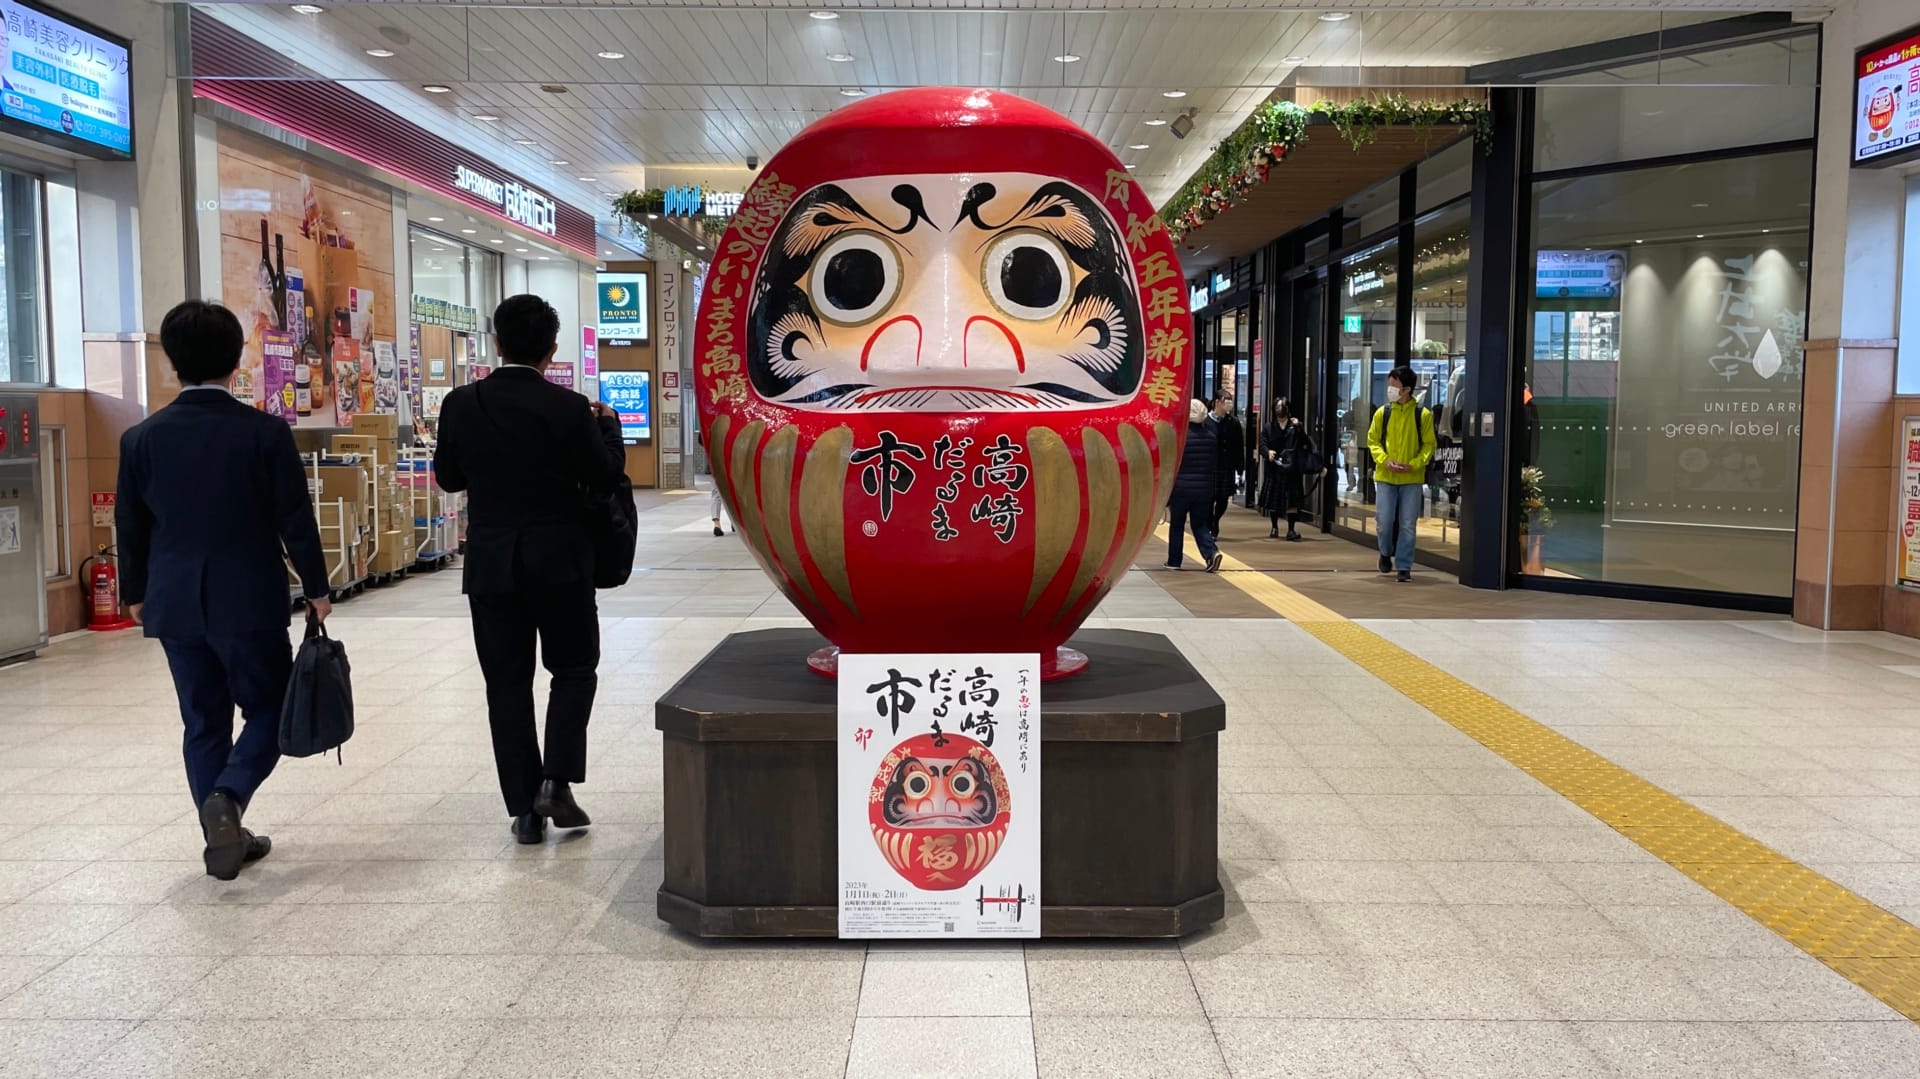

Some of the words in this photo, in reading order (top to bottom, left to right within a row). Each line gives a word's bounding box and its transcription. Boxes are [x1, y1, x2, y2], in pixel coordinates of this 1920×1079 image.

[7, 9, 128, 75] 高崎美容クリニック
[456, 165, 504, 205] SUPERMARKET
[504, 181, 556, 236] 成城石井
[705, 204, 738, 216] MET
[662, 272, 678, 361] コインロッカー
[1092, 168, 1189, 408] 令和五年新春
[607, 375, 642, 386] AEON
[607, 400, 645, 410] イーオン
[609, 389, 641, 399] 英会話
[1704, 402, 1760, 413] UNITED
[1664, 423, 1721, 439] green
[1729, 421, 1779, 437] label
[850, 430, 926, 522] 市
[932, 434, 974, 541] だるま
[971, 434, 1028, 543] 高崎
[865, 668, 923, 737] 市
[928, 668, 957, 748] だるま
[958, 666, 1000, 748] 高崎
